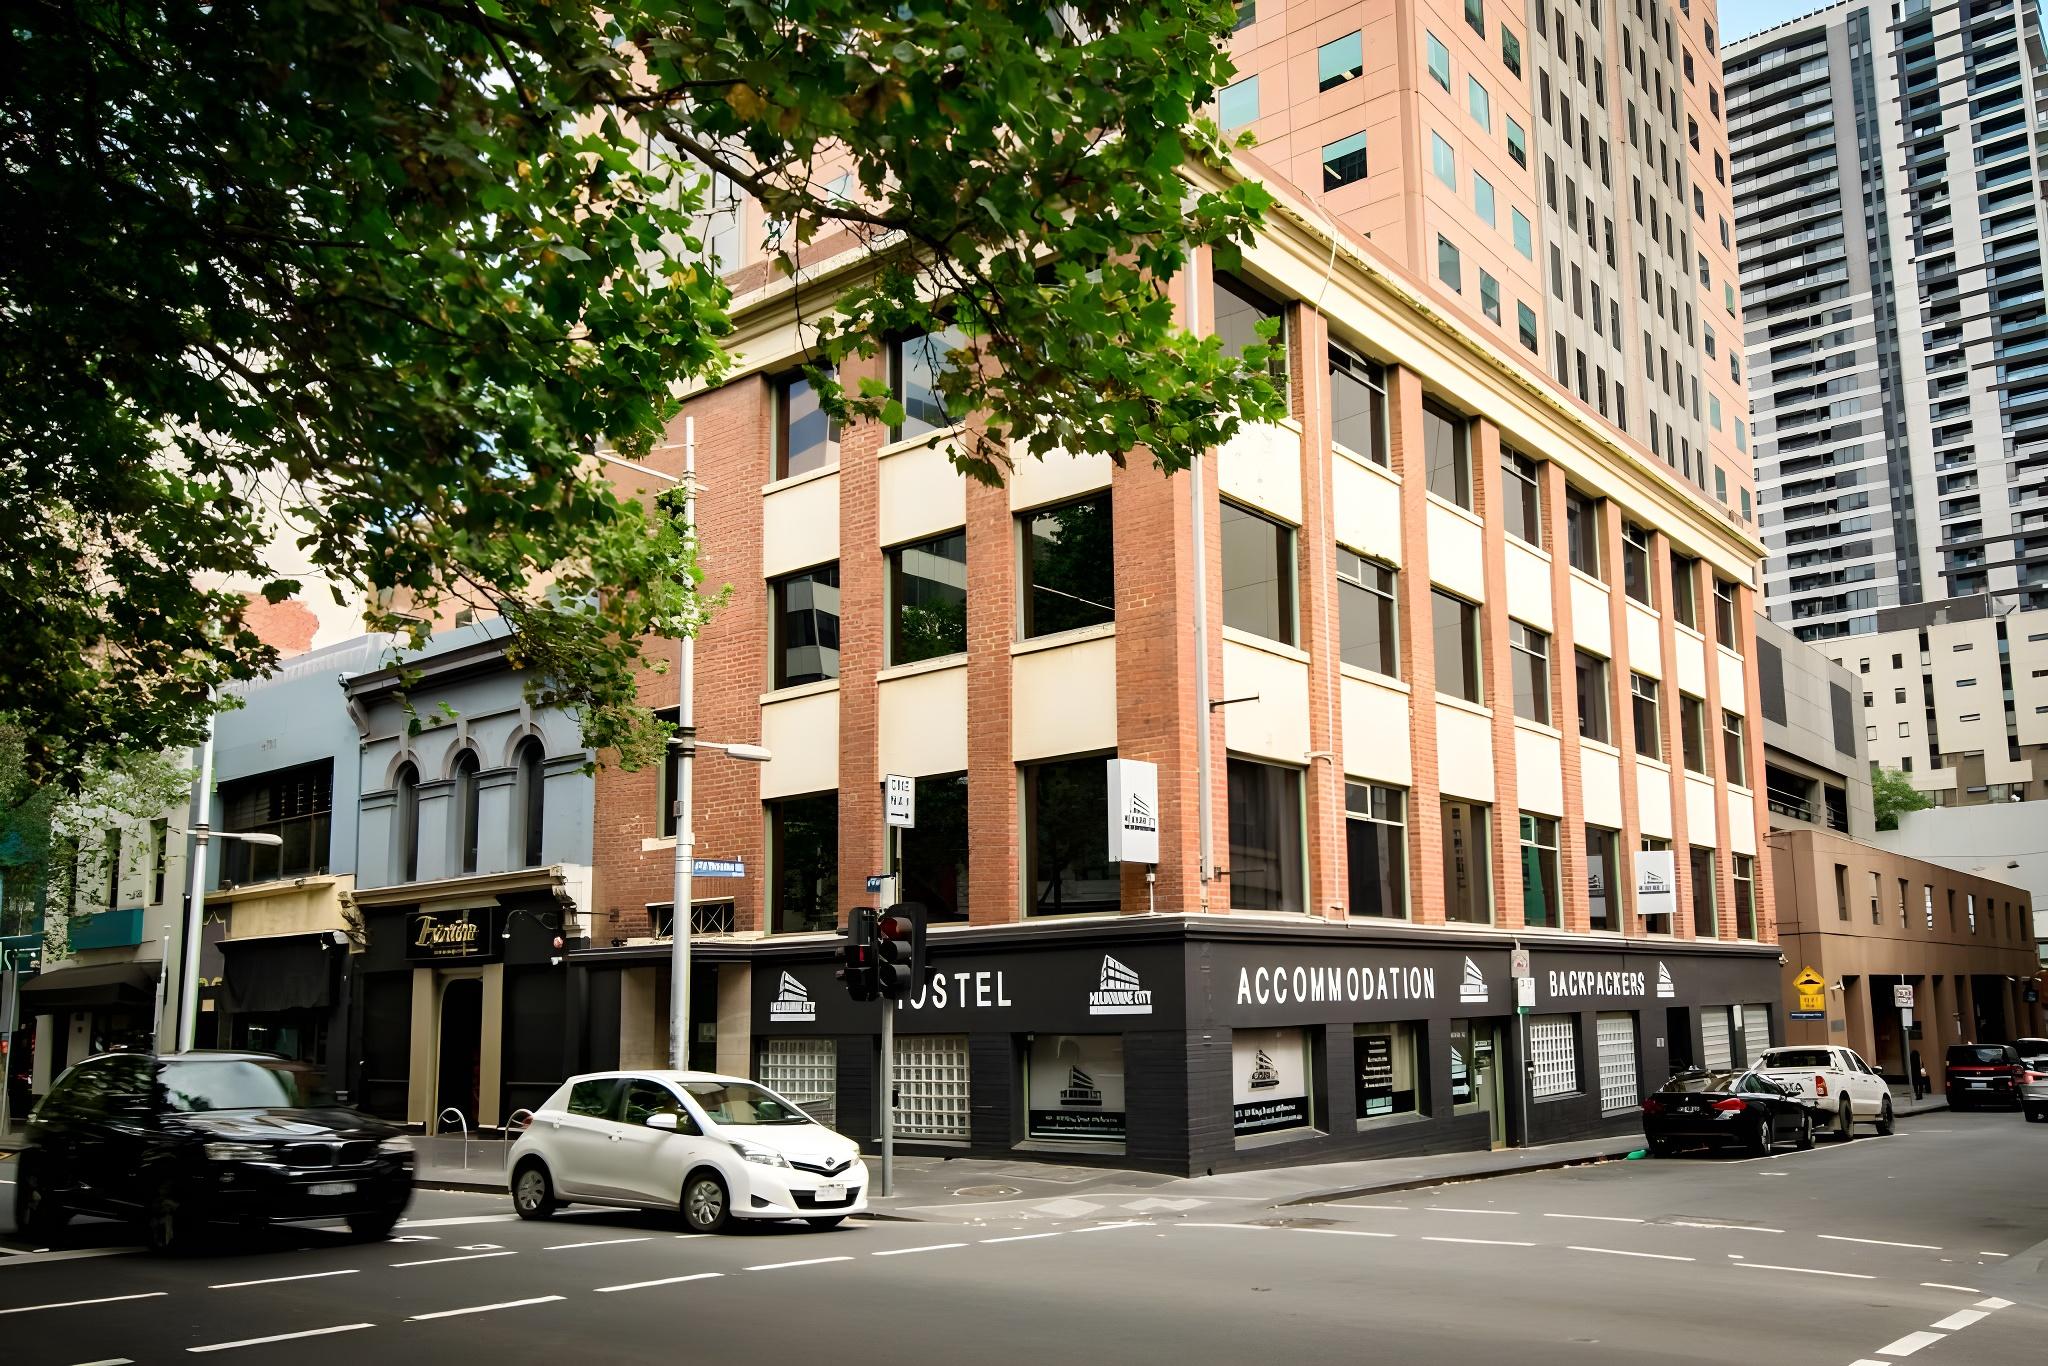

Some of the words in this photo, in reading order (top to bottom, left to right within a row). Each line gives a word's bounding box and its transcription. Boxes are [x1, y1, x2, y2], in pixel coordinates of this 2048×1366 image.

[898, 970, 1012, 1010] OSTEL
[1236, 966, 1436, 1005] ACCOMMODATION
[1549, 970, 1645, 997] BACKPACKERS
